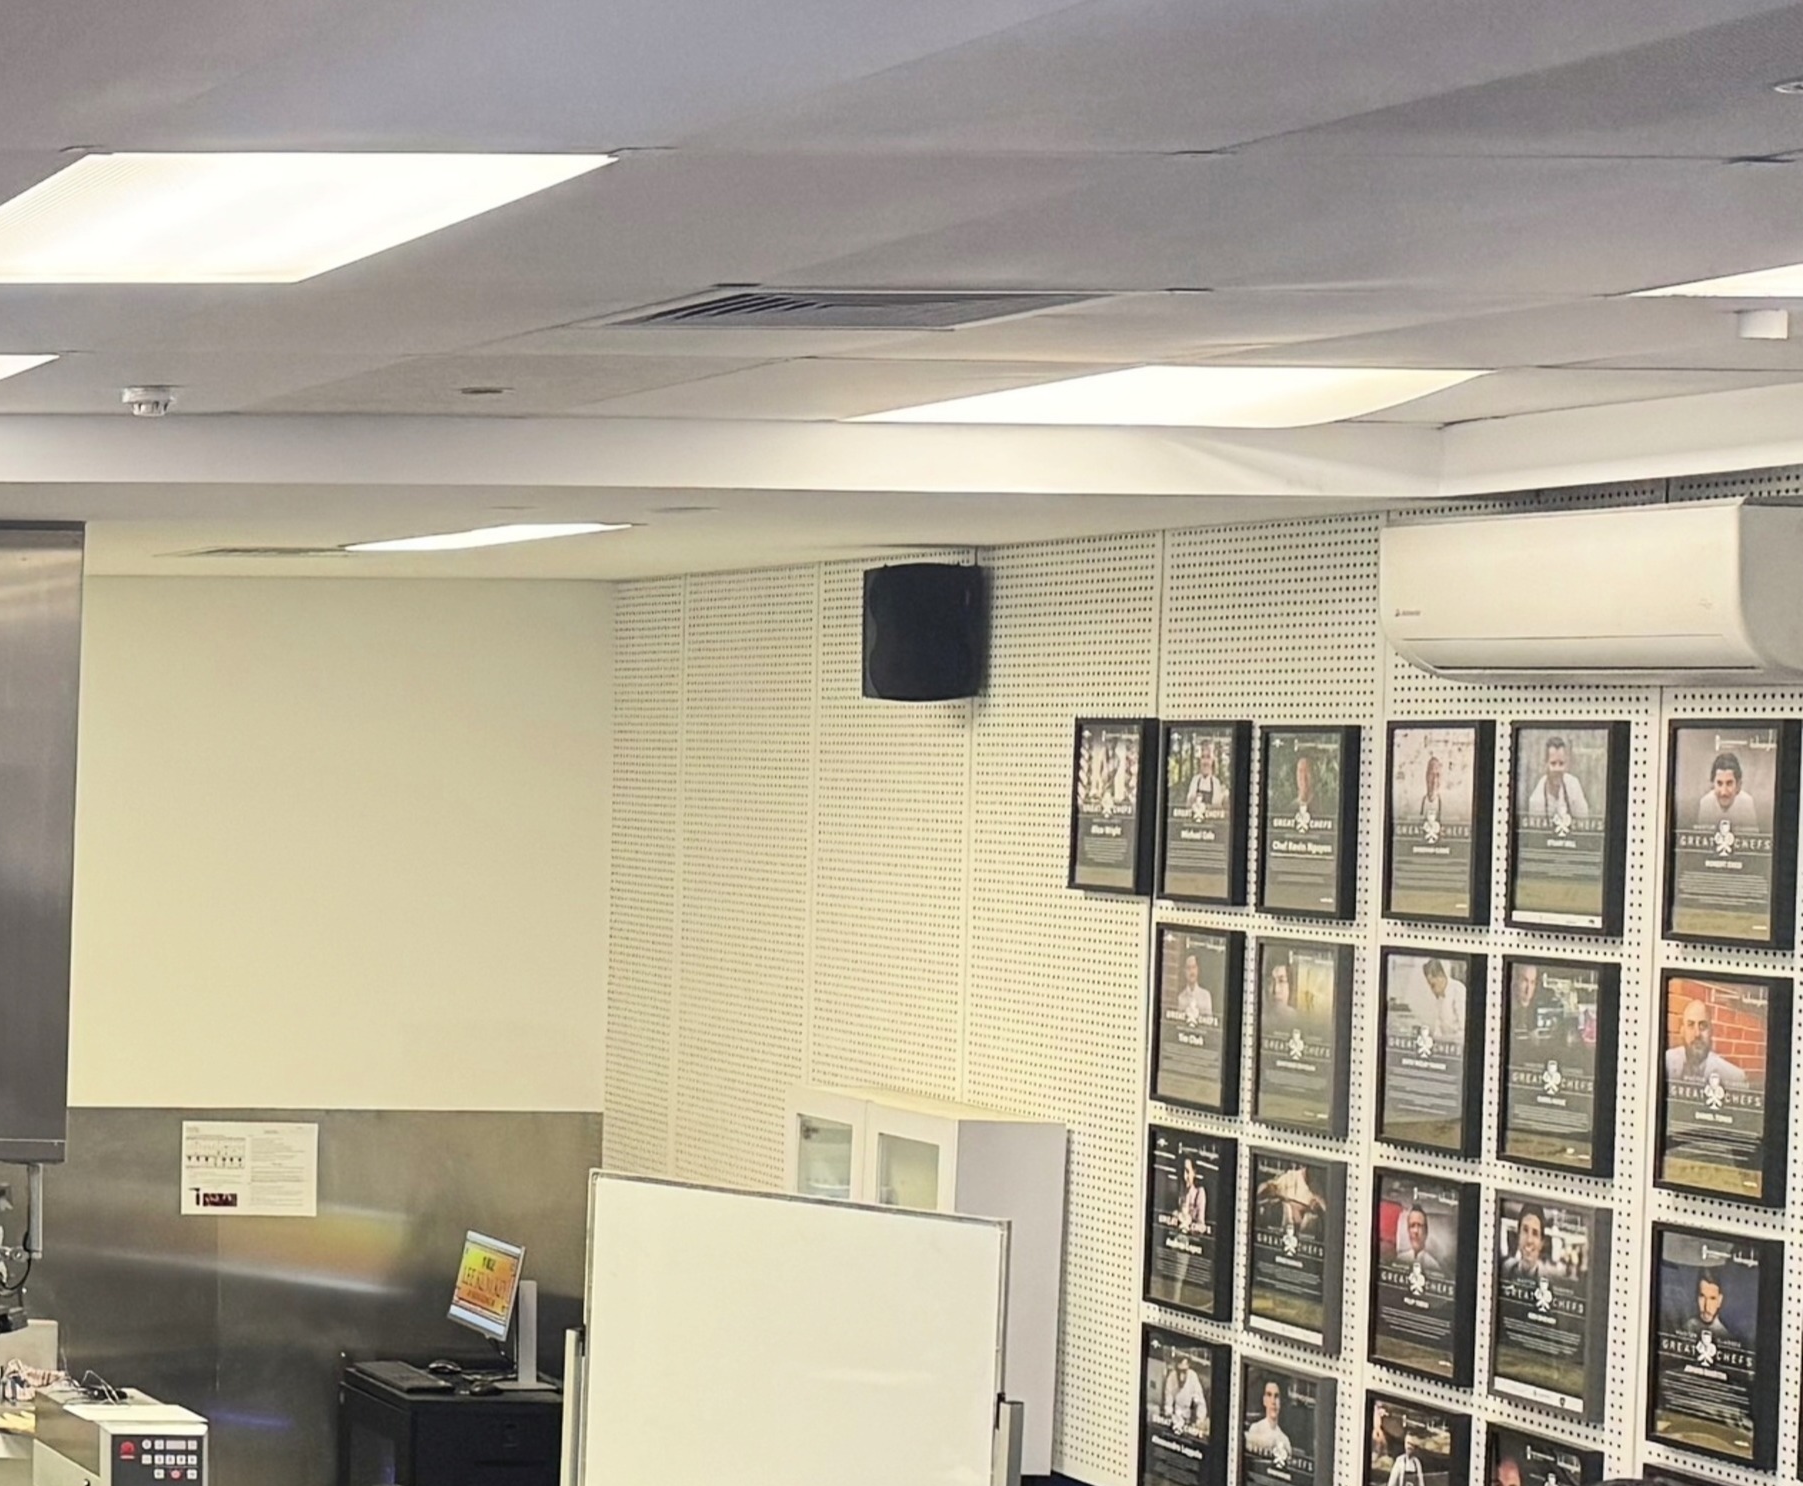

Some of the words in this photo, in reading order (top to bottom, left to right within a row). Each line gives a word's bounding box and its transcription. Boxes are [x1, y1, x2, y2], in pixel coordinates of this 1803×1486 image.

[1679, 835, 1715, 848] GREAT
[1734, 837, 1771, 850] CHEFS
[1670, 1085, 1704, 1099] GREAT
[1724, 1093, 1762, 1108] CHEFS
[1662, 1339, 1696, 1355] GREAT
[1715, 1350, 1753, 1368] CHEFS
